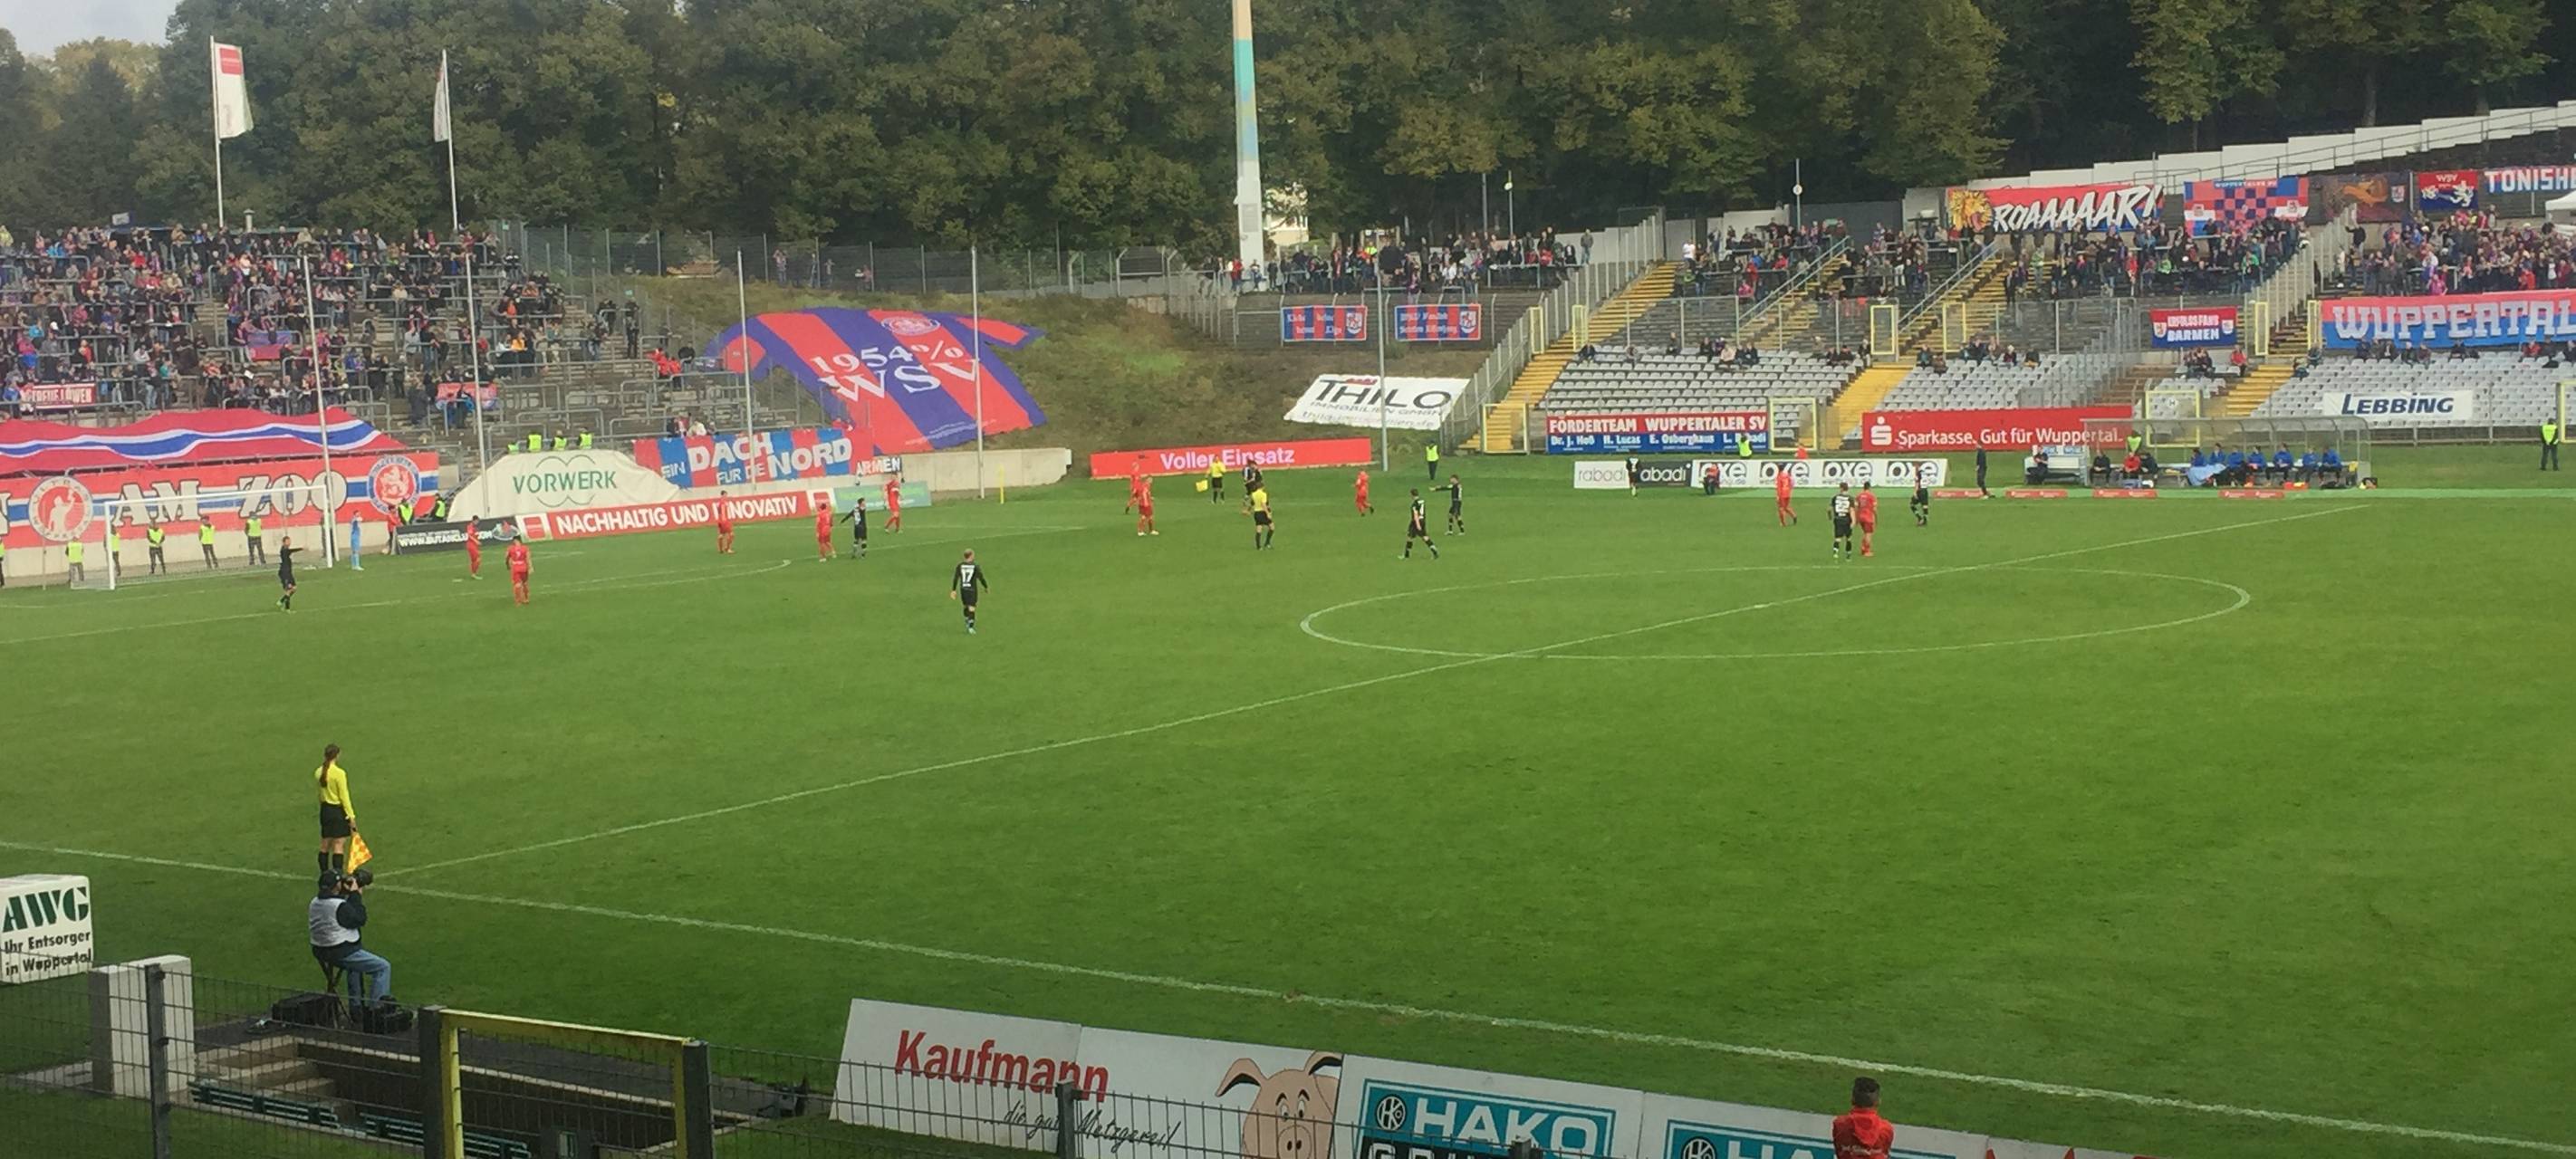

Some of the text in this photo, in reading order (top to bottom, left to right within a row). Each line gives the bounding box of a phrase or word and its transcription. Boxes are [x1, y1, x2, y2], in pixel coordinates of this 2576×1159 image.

[2333, 300, 2576, 340] WUPPERTAL
[817, 358, 980, 402] WSV
[1316, 378, 1452, 409] THILO
[1549, 416, 1766, 434] FÖRDERTEAM WUPPERTALER SV
[1898, 426, 2123, 448] Sparkasse. Gut für Wuppertal.
[686, 431, 852, 479] DACH NORD
[1551, 436, 1565, 446] Dr.
[1567, 436, 1574, 448] J.
[1616, 435, 1641, 445] Lucas
[1649, 434, 1659, 444] E.
[1723, 433, 1733, 444] L.
[660, 461, 687, 479] EIN
[1160, 447, 1295, 471] Voller Einsatz
[1822, 461, 1873, 477] oxe
[513, 470, 618, 494] VORWERK
[110, 479, 202, 527] AM
[237, 469, 348, 519] ZOO
[555, 495, 797, 535] NACHHALTIG UND INOVATIV
[2, 886, 90, 934] AWG
[4, 931, 91, 954] Ihr Entsorger
[5, 947, 92, 976] in Wuppertal
[894, 1029, 1110, 1103] Kaufmann
[1412, 1097, 1599, 1159] HAKO
